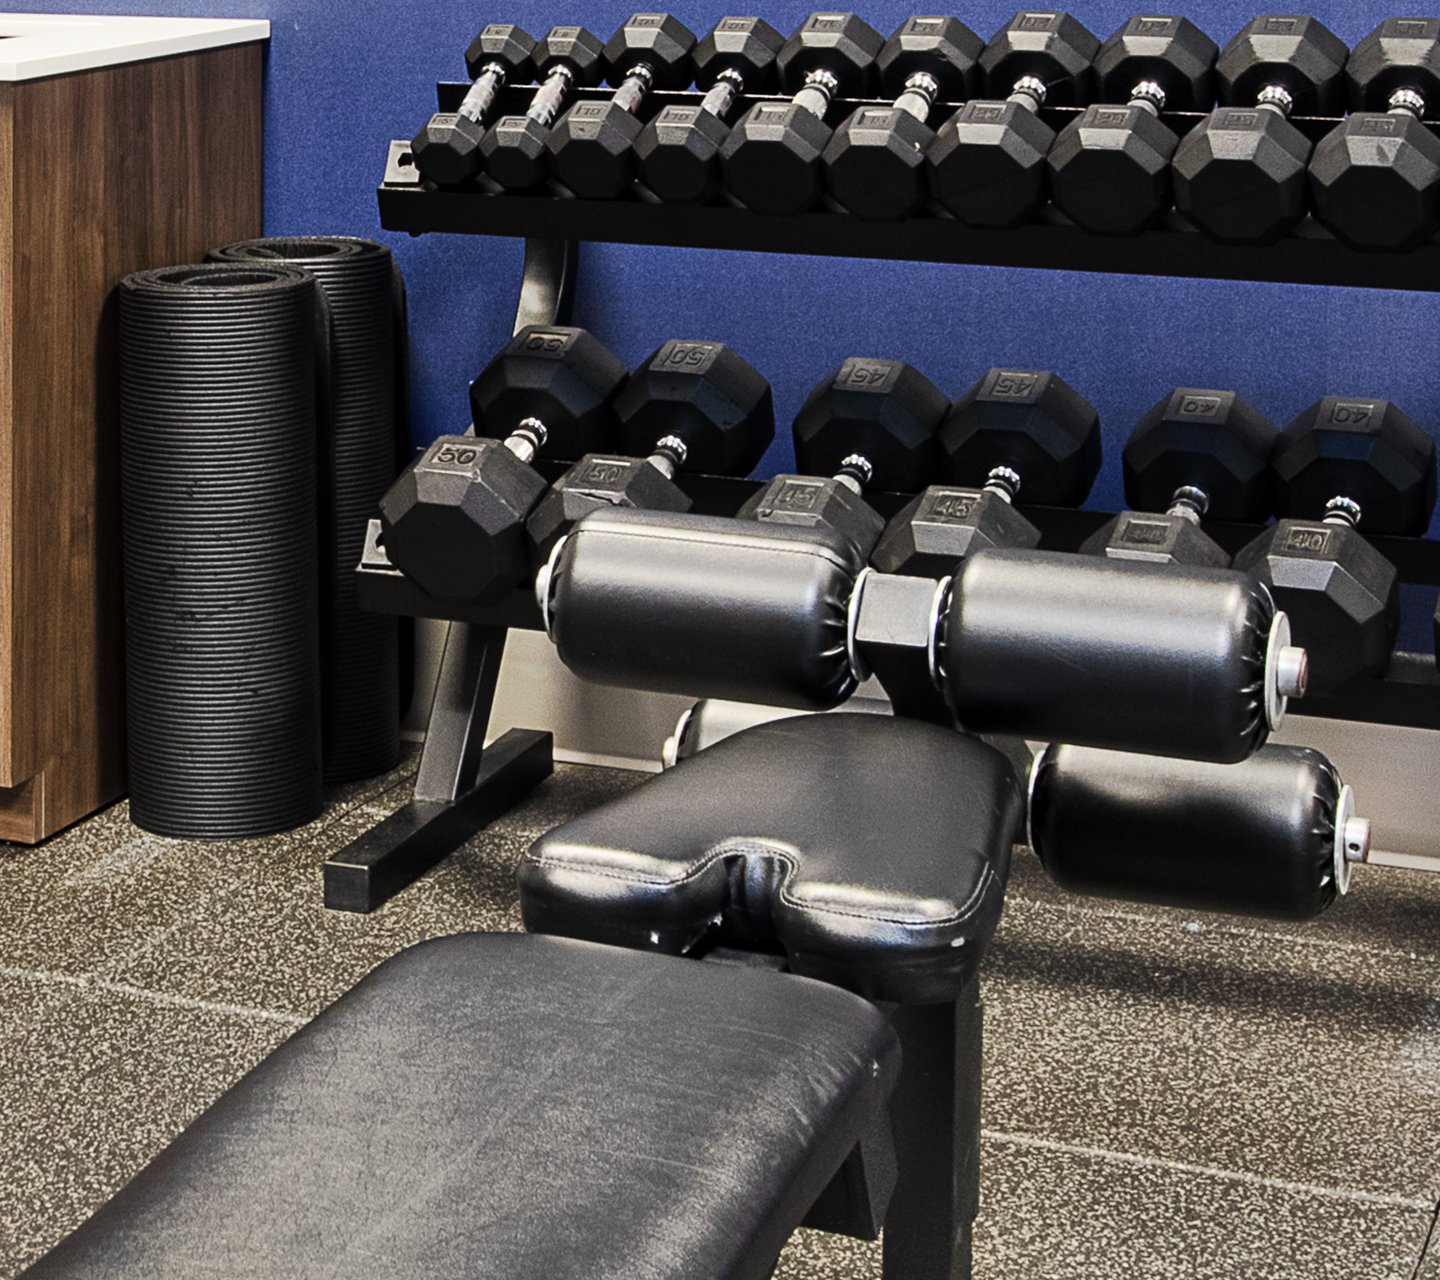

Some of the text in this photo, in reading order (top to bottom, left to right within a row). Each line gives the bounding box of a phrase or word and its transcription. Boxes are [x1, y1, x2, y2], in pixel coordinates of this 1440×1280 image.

[525, 336, 564, 353] 50
[669, 348, 706, 367] 50
[851, 367, 887, 384] 45
[995, 377, 1033, 394] 45
[1182, 400, 1216, 414] 40
[1333, 407, 1368, 423] 40
[436, 447, 478, 465] 50
[586, 465, 619, 483] 50
[779, 487, 816, 503] 45
[936, 499, 971, 518] 45
[1291, 531, 1325, 549] 40
